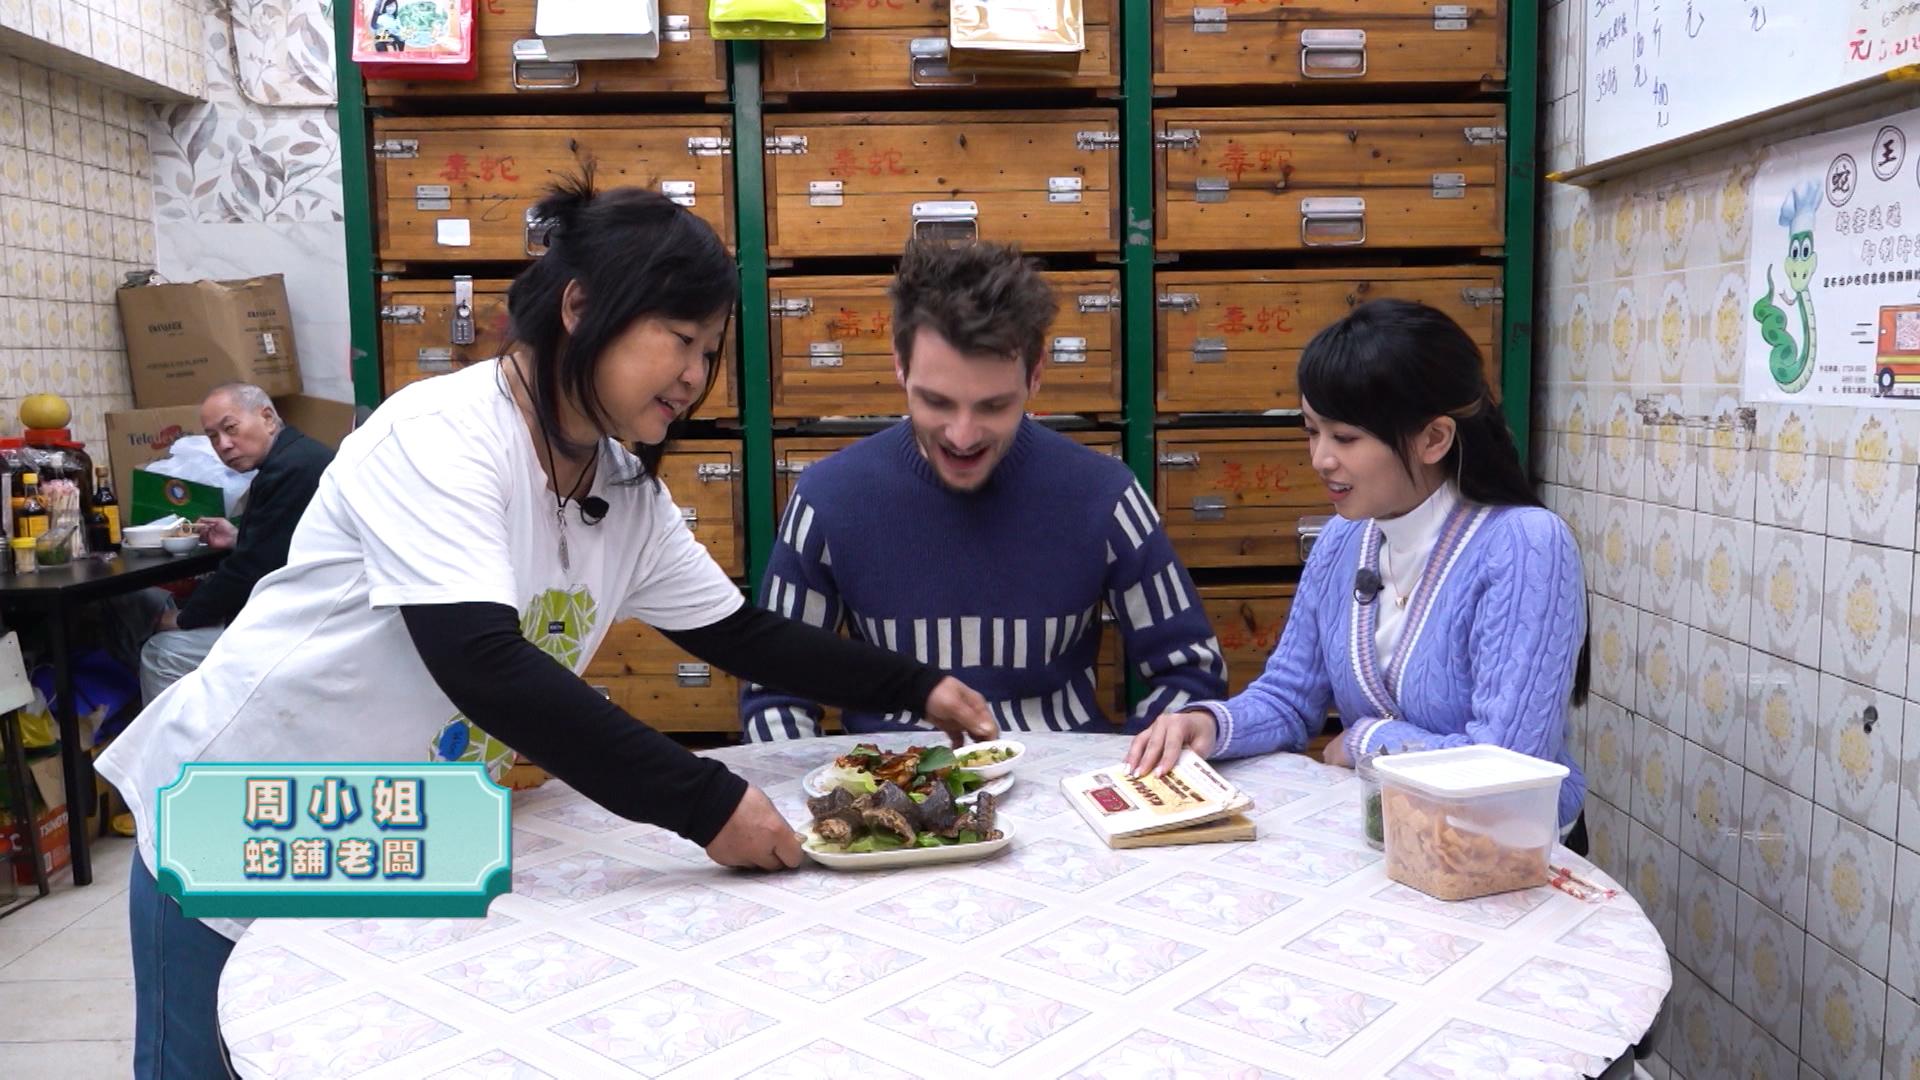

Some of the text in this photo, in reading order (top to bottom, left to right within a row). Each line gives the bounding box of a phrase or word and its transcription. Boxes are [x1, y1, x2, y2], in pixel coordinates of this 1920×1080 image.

[439, 153, 520, 183] 毒蛇
[829, 147, 908, 177] 毒蛇
[1217, 144, 1296, 182] 毒蛇
[1215, 304, 1296, 336] 毒蛇
[1213, 462, 1294, 493] 毒蛇
